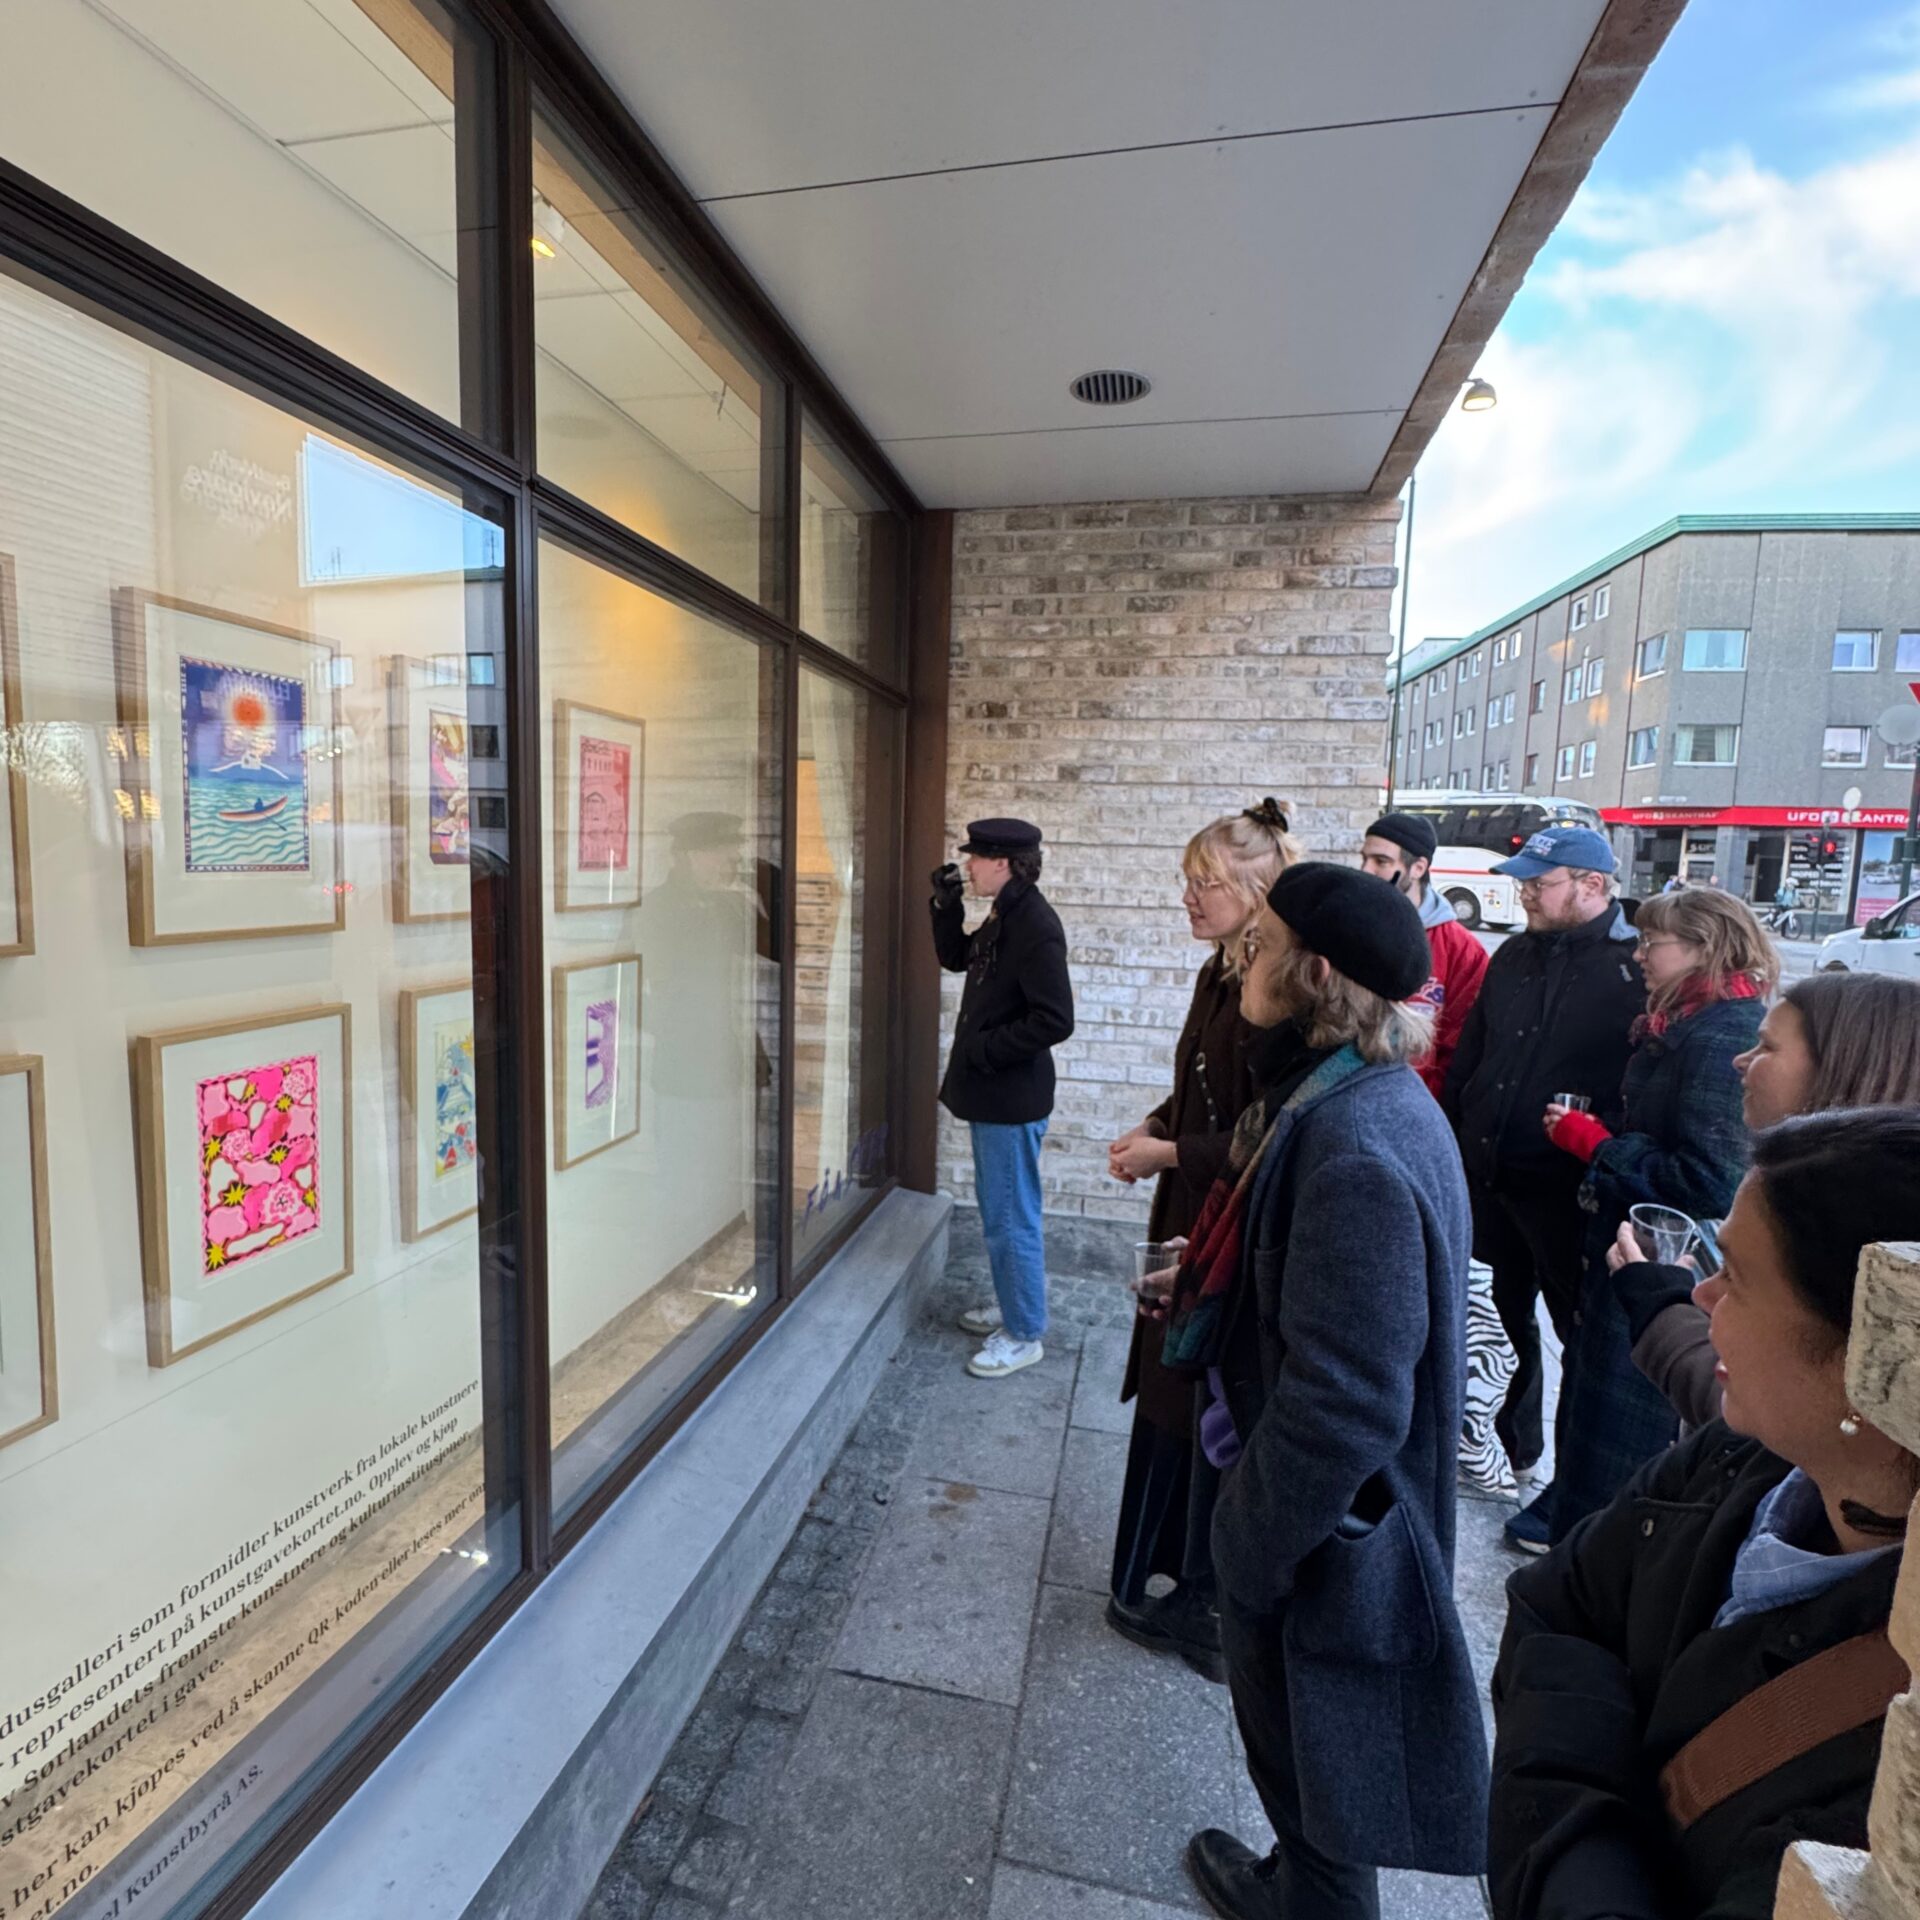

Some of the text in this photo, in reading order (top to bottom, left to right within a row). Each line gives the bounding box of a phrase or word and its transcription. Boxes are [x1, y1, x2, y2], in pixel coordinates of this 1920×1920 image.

[1787, 811, 1820, 822] UFO
[10, 1416, 458, 1770] representert på kunstgavekortet.no. Opplev og kjøp
[24, 1680, 154, 1792] Sørlandets
[159, 1616, 237, 1684] fremste
[240, 1544, 326, 1620] kunstnere
[329, 1526, 348, 1548] og
[350, 1430, 472, 1532] kulturinstitusjoner.
[130, 1603, 175, 1643] som
[180, 1530, 270, 1607] formidler
[273, 1470, 353, 1538] kunstverk
[356, 1454, 377, 1477] fra
[379, 1423, 418, 1460] lokale
[420, 1379, 479, 1430] kunstnere
[13, 1859, 58, 1908] her
[65, 1815, 110, 1863] kan
[116, 1747, 186, 1818] kjøpes
[190, 1709, 225, 1748] ved
[228, 1696, 240, 1717] å
[244, 1642, 304, 1703] skanne
[308, 1576, 379, 1645] QR-koden
[381, 1549, 410, 1581] eller
[413, 1519, 442, 1553] leses
[444, 1497, 468, 1526] mer
[162, 1695, 169, 1714] i
[174, 1657, 225, 1709] gave.
[125, 1789, 232, 1905] Kunstbyrå
[236, 1764, 263, 1798] AS.
